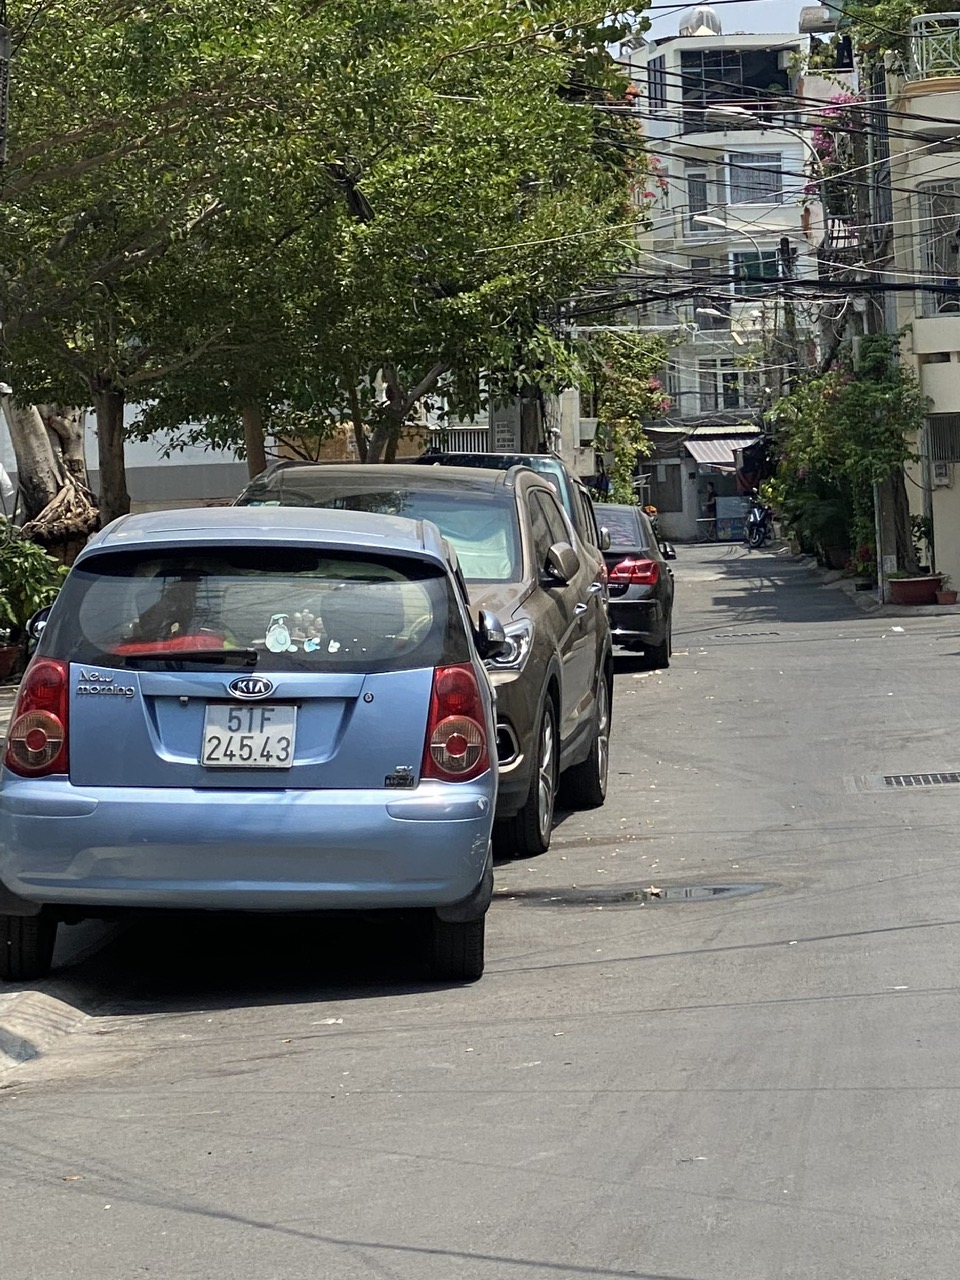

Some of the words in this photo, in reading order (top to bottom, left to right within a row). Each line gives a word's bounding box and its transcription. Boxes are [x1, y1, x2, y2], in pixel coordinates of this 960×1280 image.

[78, 668, 115, 682] New
[76, 683, 136, 698] morning
[237, 681, 265, 693] KIA
[227, 707, 275, 734] 51F
[205, 735, 291, 762] 245.43
